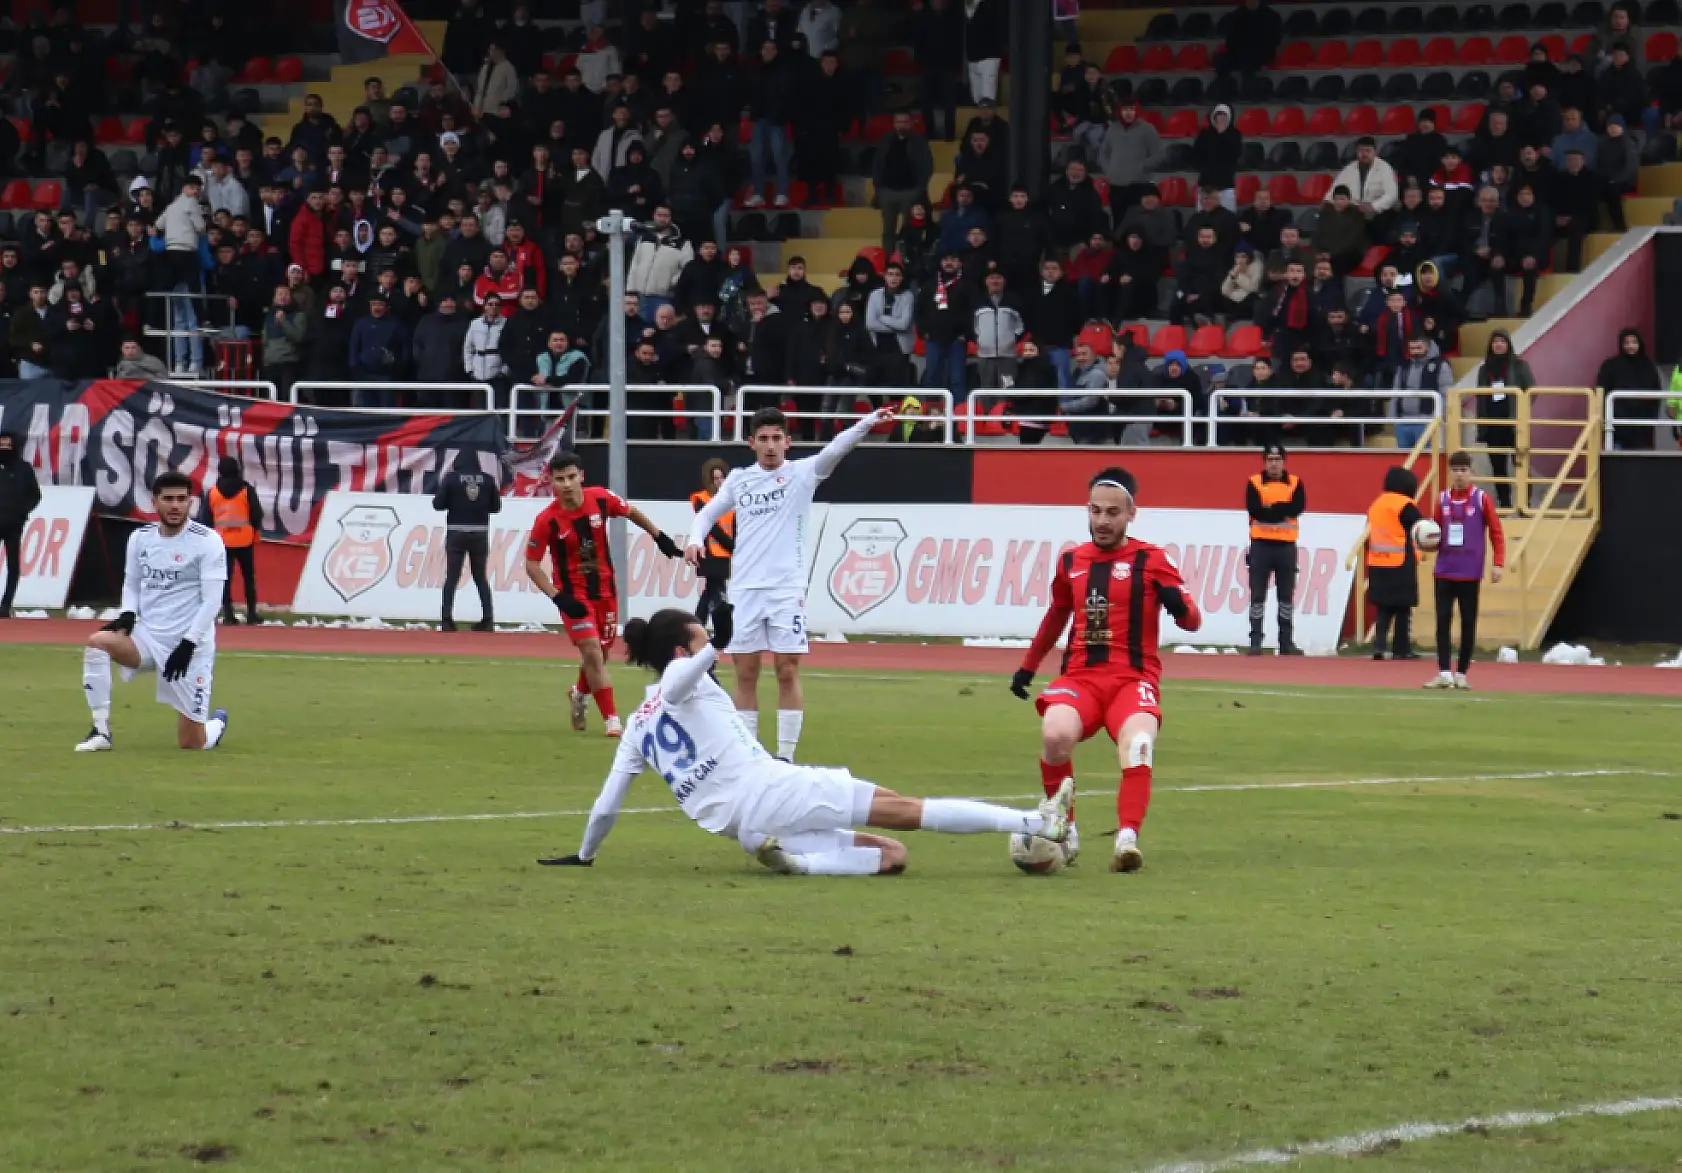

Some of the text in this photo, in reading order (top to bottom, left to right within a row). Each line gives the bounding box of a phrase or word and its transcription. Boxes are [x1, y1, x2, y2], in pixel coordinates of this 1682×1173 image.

[0, 403, 90, 486] AR
[0, 517, 70, 578] OR
[906, 536, 993, 606] GMG
[838, 569, 887, 597] KS
[641, 711, 696, 785] 29
[694, 756, 719, 781] CAN
